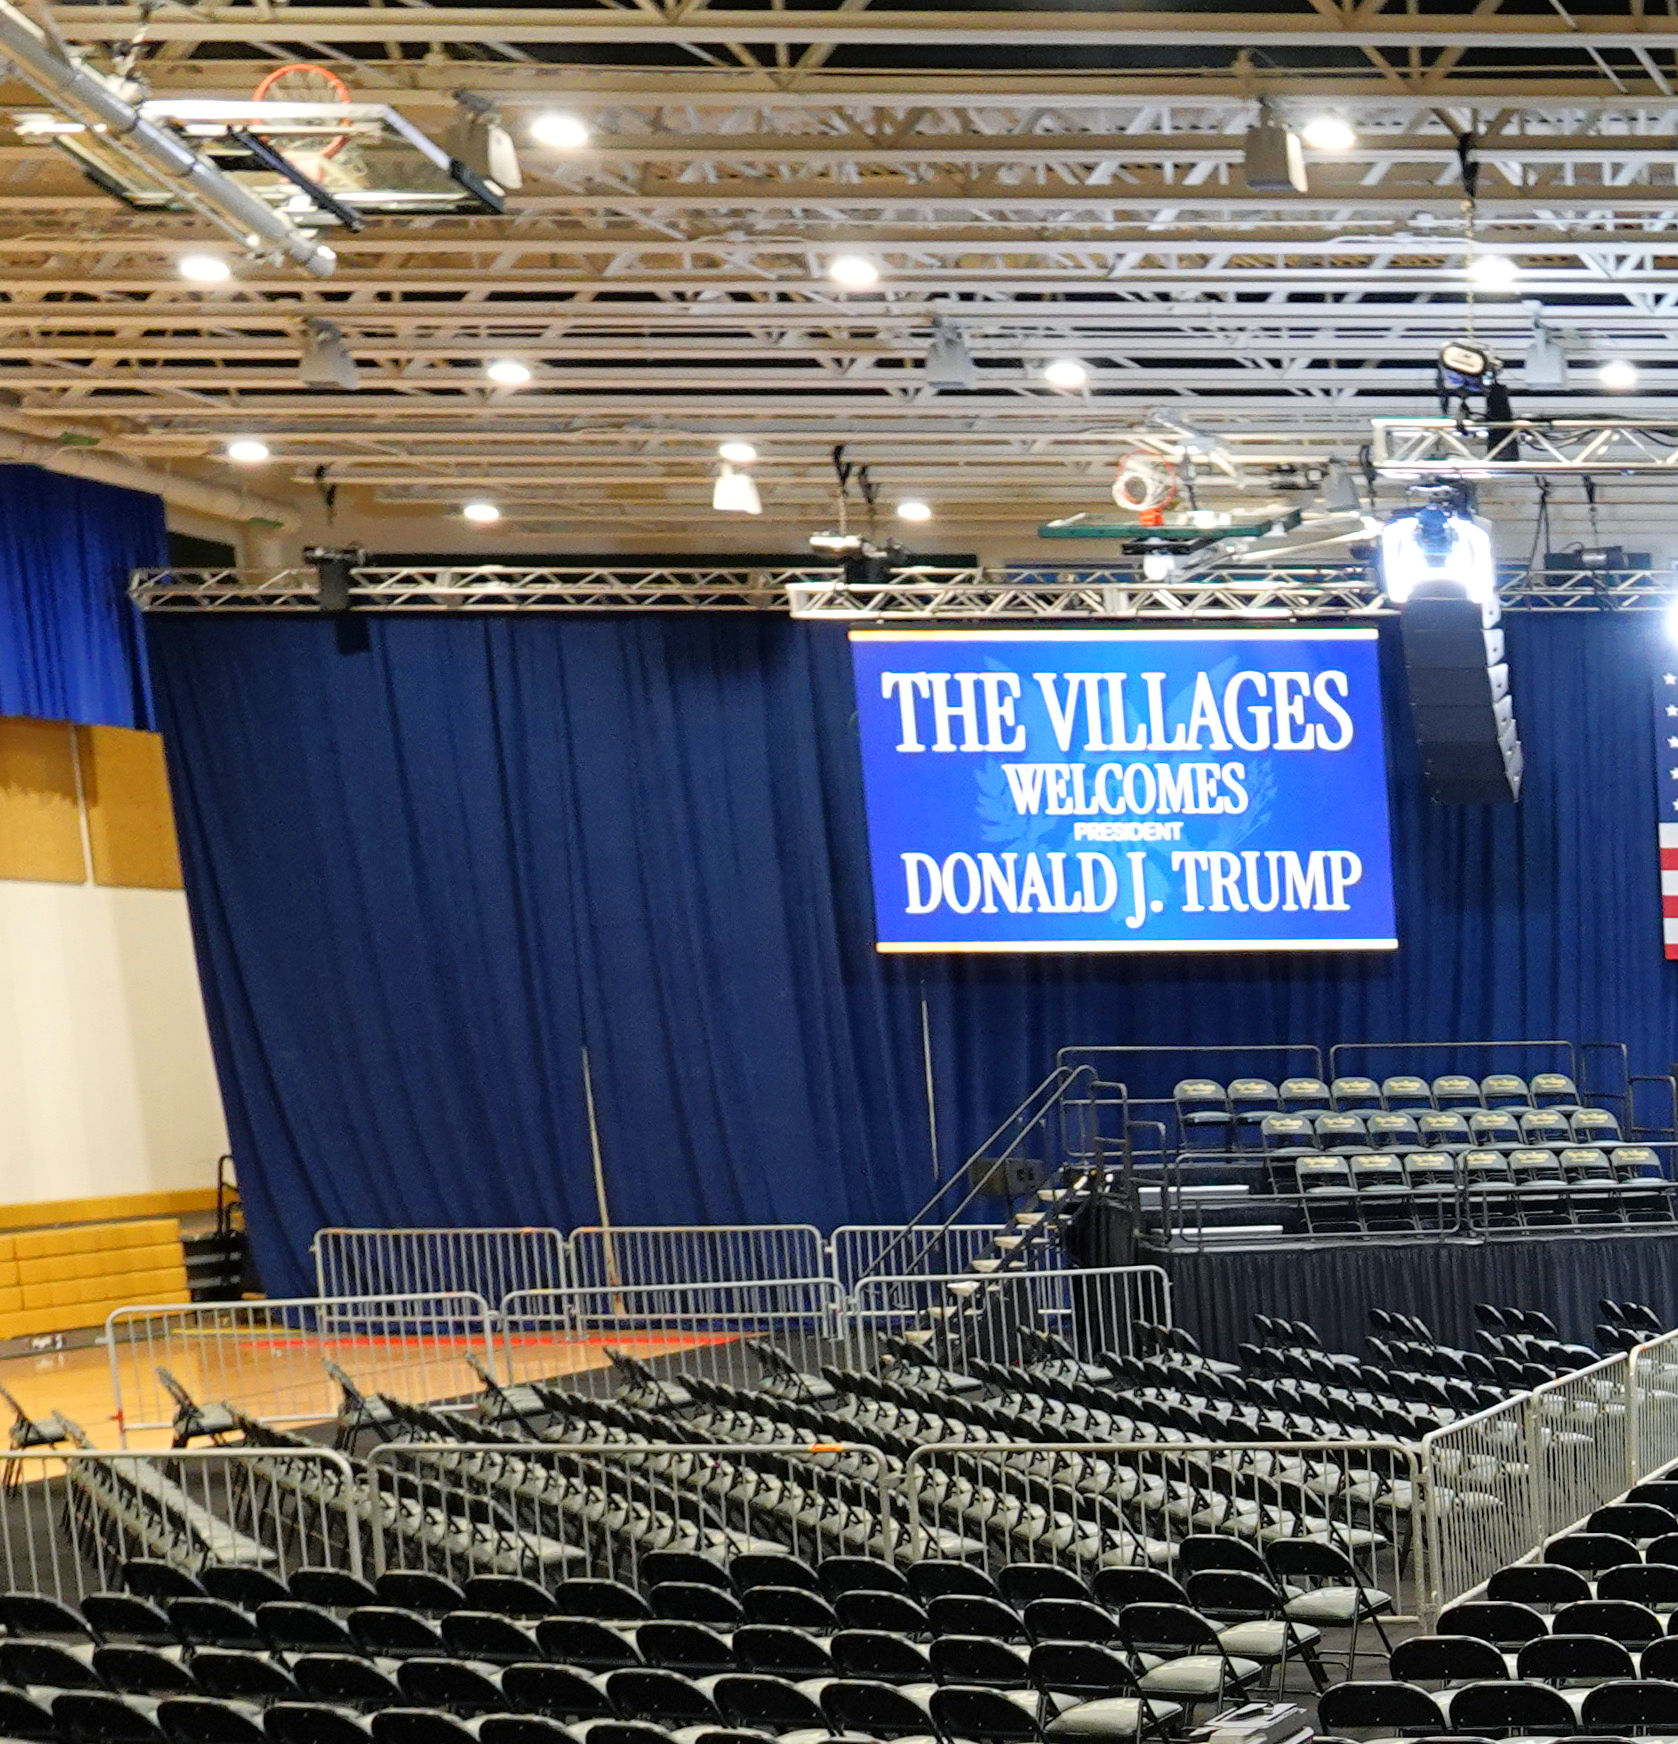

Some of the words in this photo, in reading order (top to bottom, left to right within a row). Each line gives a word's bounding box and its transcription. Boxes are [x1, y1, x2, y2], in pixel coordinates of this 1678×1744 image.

[882, 672, 1026, 752] THE
[1033, 670, 1353, 751] VILLAGES
[1002, 762, 1248, 815] WELCOMES
[1074, 822, 1183, 841] PRESIDENT
[901, 852, 1117, 913] DONALD
[1126, 852, 1163, 928] J.
[1171, 851, 1362, 912] TRUMP
